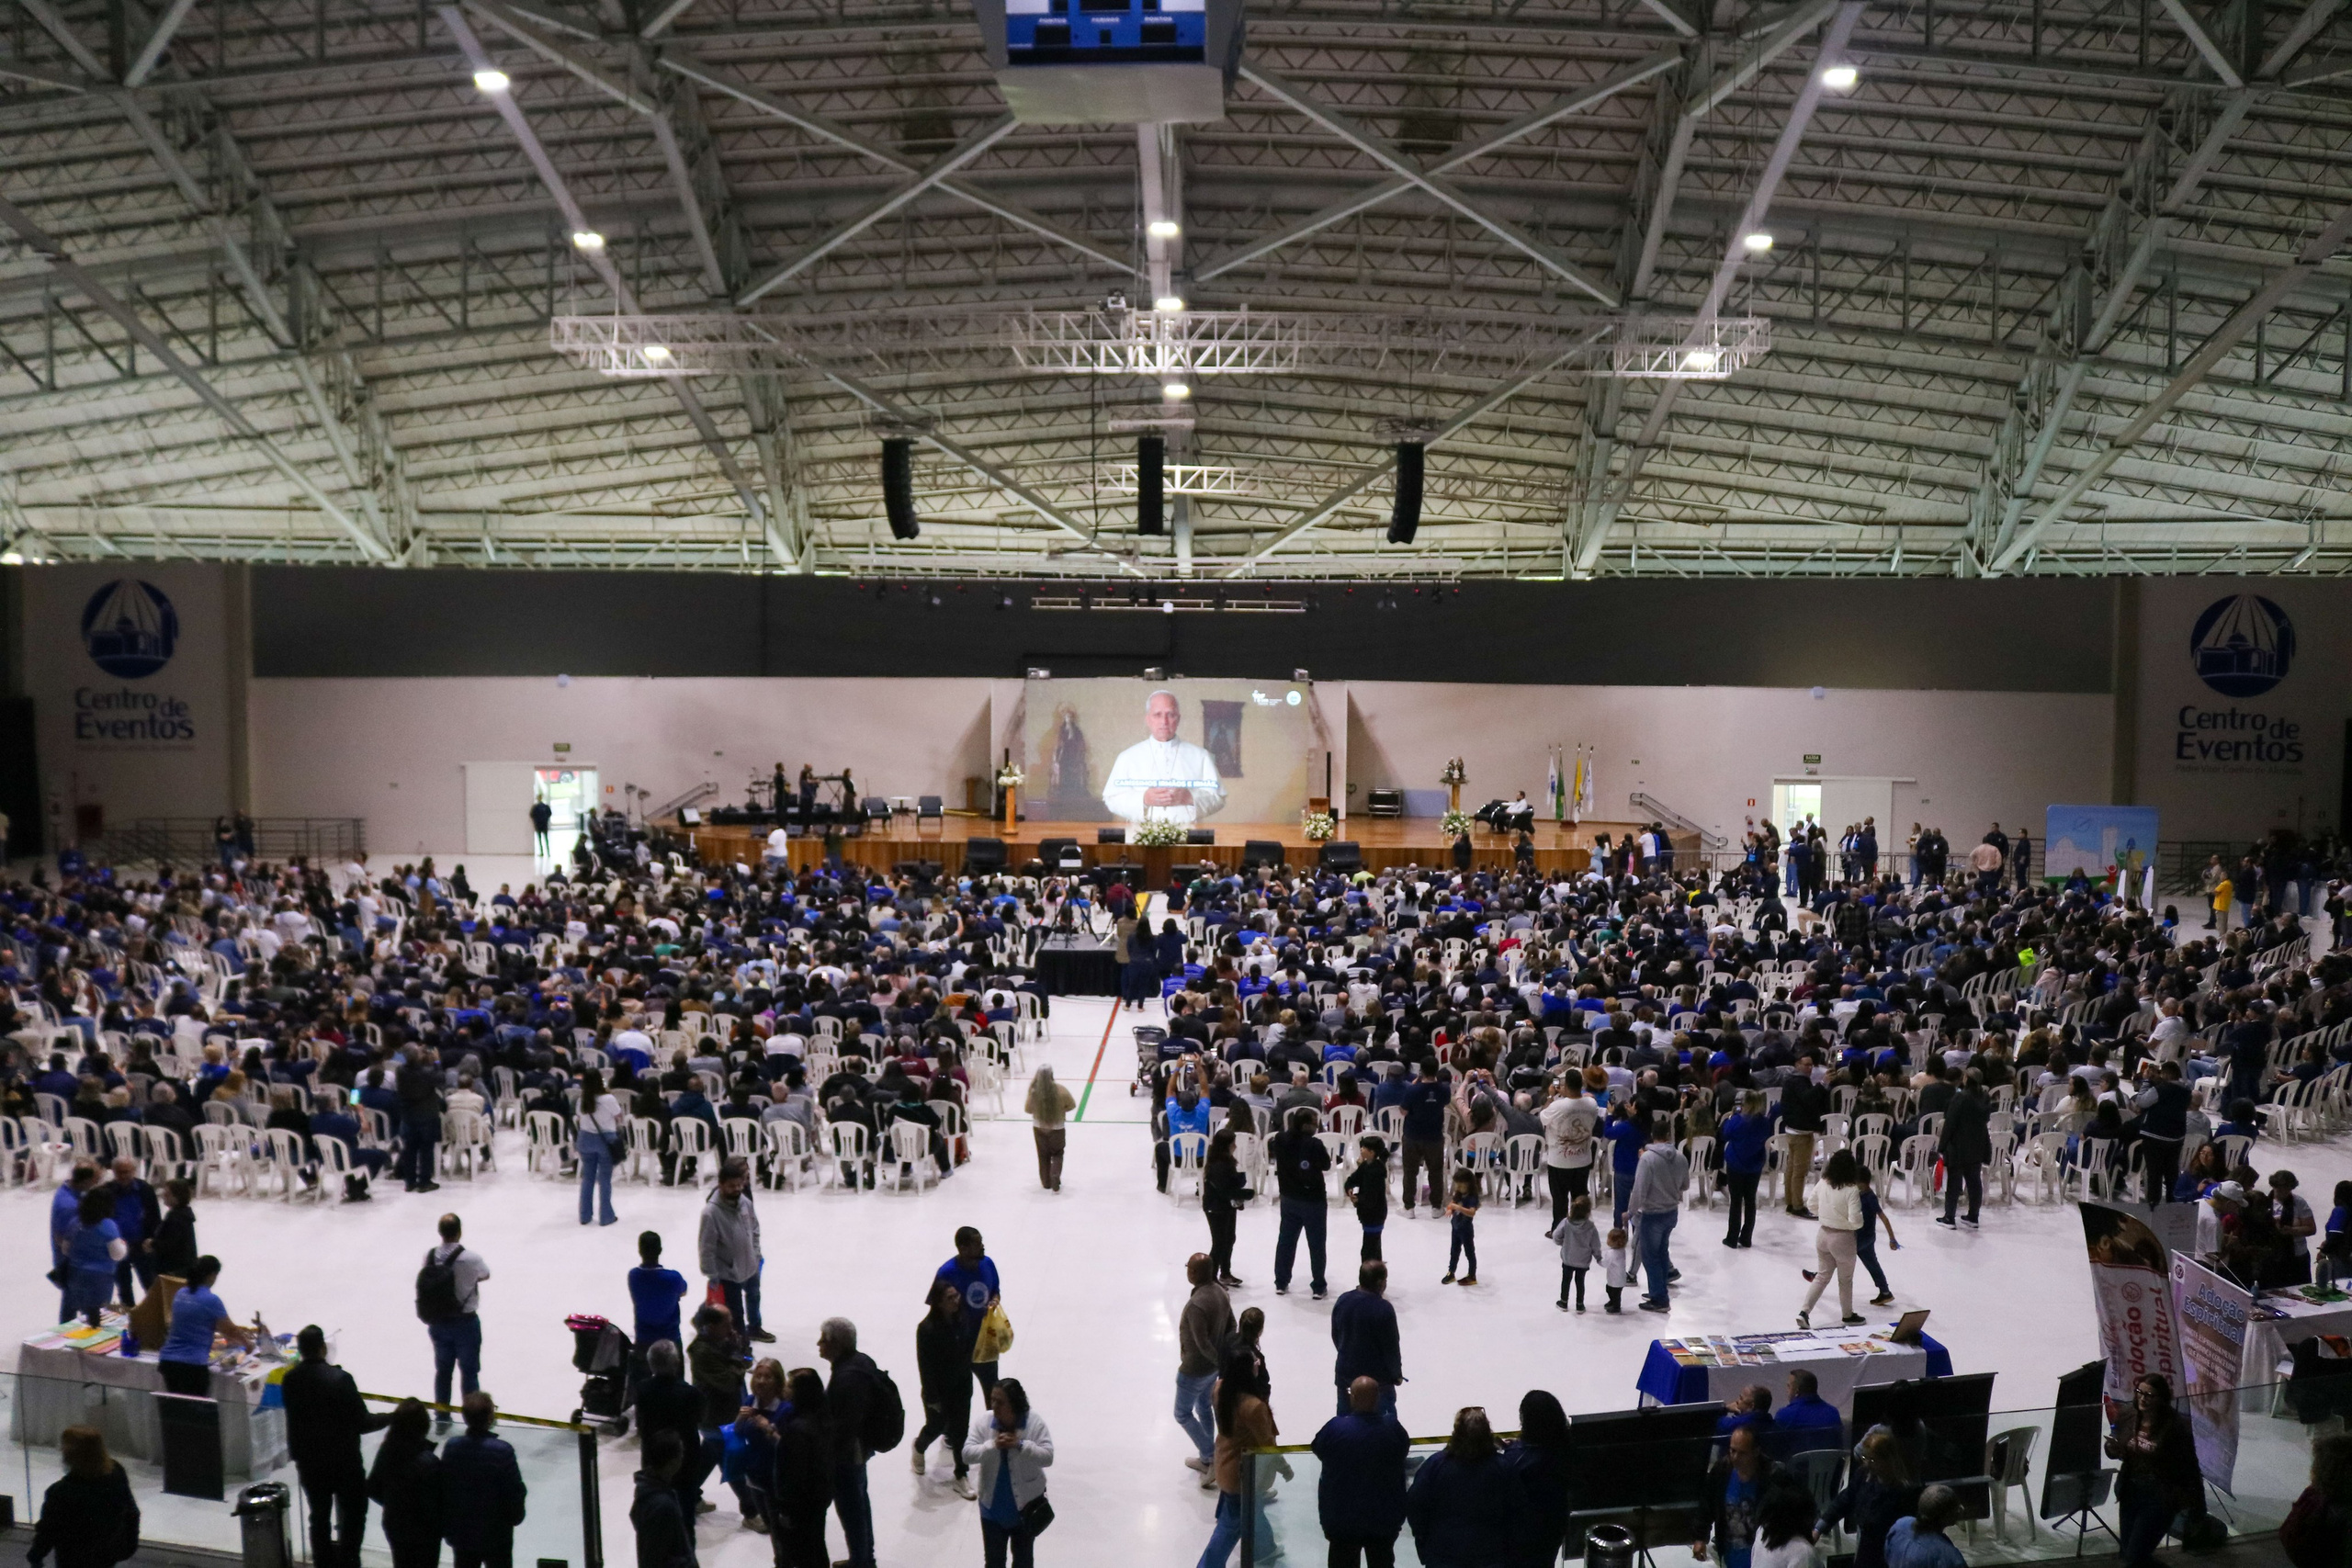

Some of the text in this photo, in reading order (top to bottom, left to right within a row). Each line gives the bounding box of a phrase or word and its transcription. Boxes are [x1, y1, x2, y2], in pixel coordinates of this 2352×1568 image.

[75, 687, 188, 716] Centro de
[75, 712, 194, 739] Eventos
[2178, 705, 2300, 739] Centro de
[2177, 731, 2304, 761] Eventos
[1158, 778, 1186, 787] IRMÃOS
[2176, 763, 2199, 773] Padre
[2222, 765, 2253, 774] Coelho
[2255, 766, 2265, 775] de
[2198, 1282, 2245, 1324] Adoção
[2183, 1295, 2245, 1347] Espiritual
[2150, 1287, 2177, 1387] spiritual
